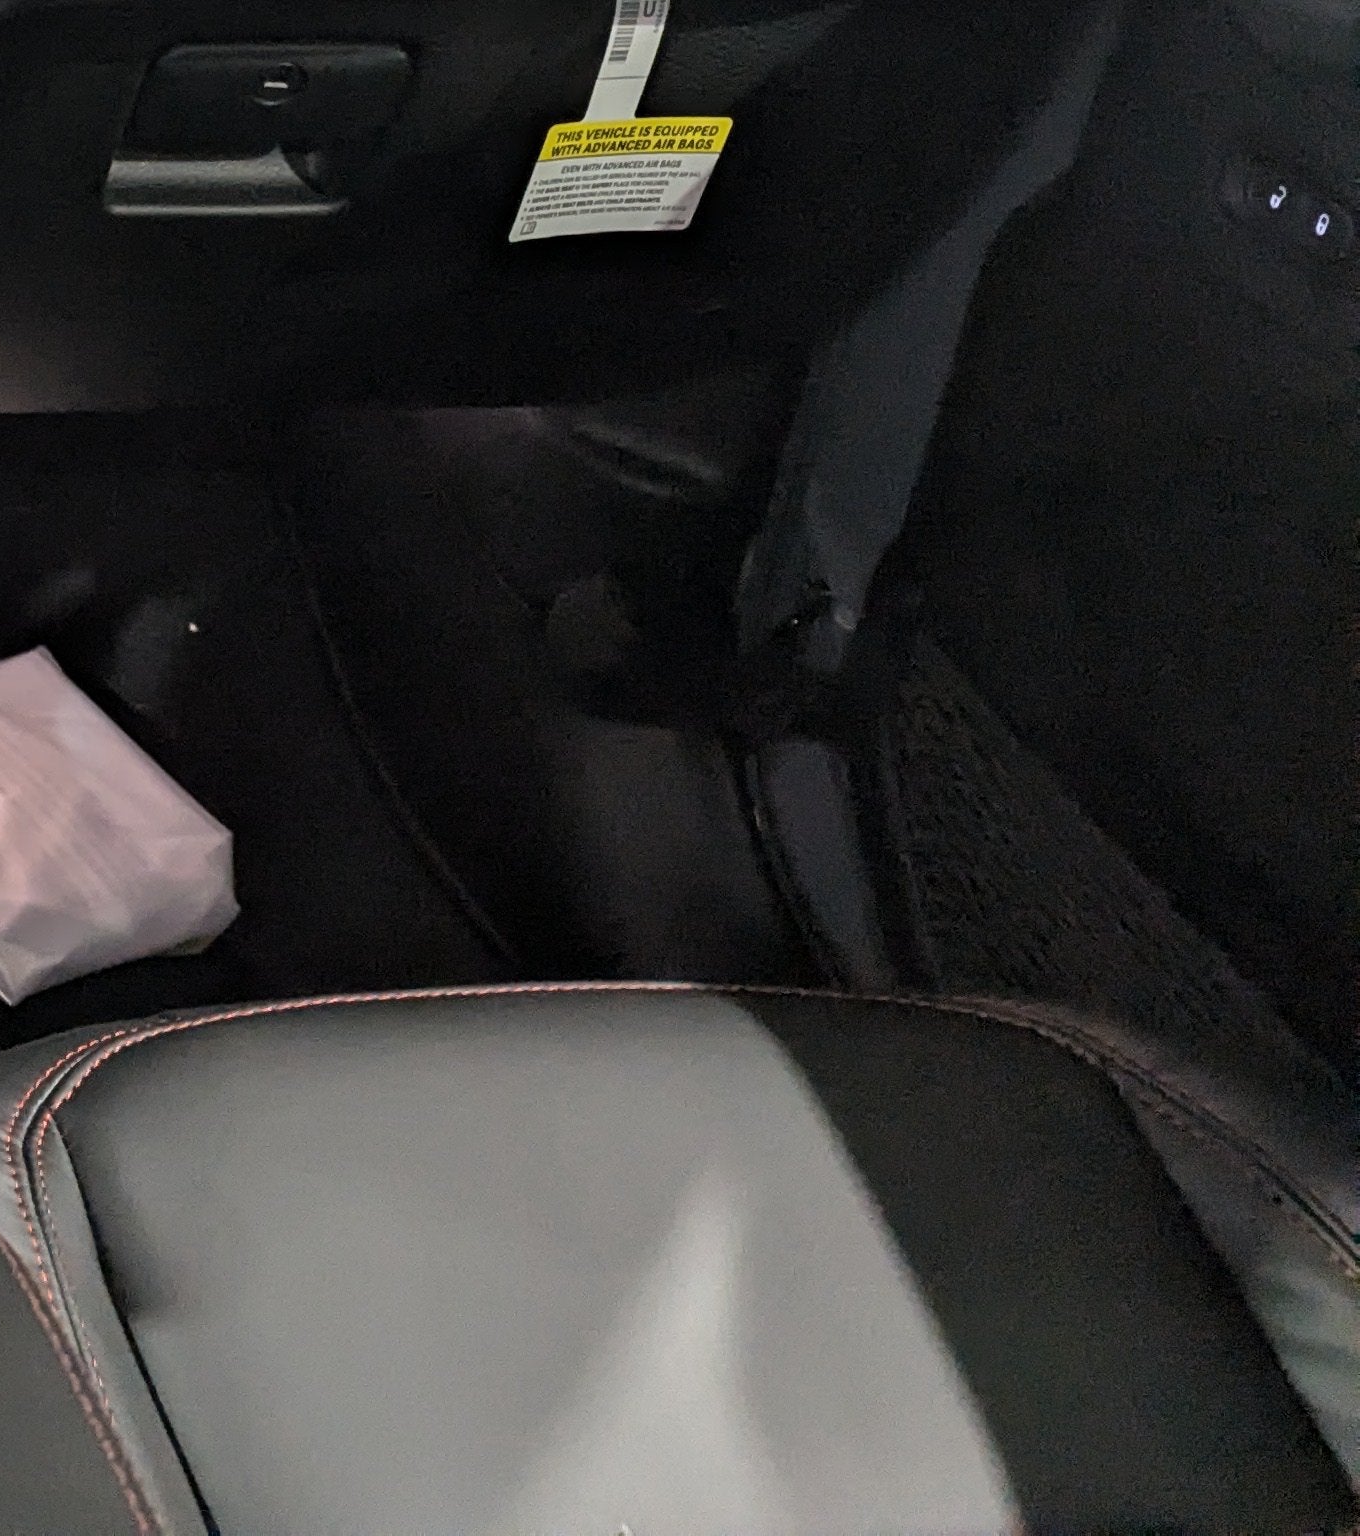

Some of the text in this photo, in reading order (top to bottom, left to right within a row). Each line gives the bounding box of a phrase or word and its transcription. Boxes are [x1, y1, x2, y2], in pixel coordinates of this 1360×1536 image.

[643, 0, 656, 17] U
[556, 126, 719, 142] THIS VEHICLE IS EQUIPPED
[551, 139, 713, 157] WITH ADVANCED AIR BAGS
